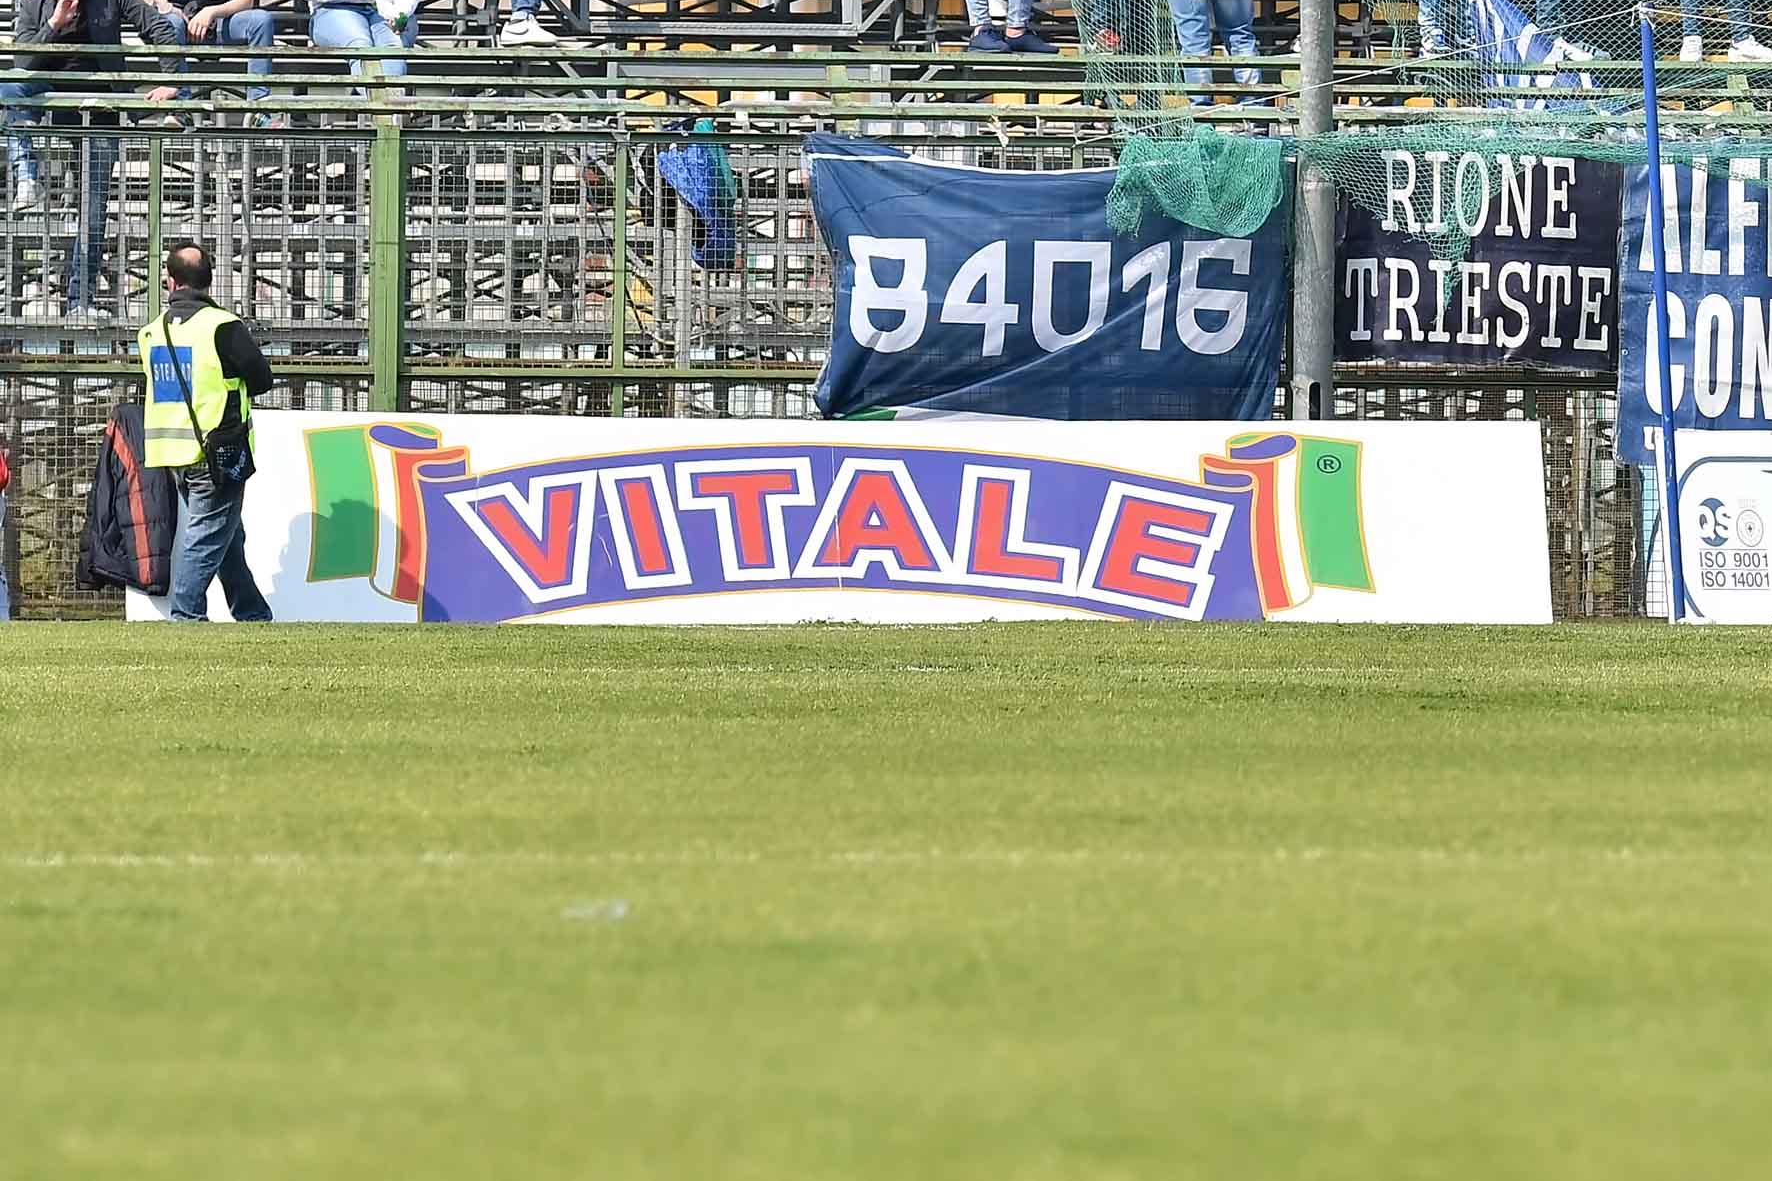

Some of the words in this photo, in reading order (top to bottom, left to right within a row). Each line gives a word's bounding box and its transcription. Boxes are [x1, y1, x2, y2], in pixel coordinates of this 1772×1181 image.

[1381, 149, 1578, 241] RIONE
[847, 237, 1252, 357] 84016
[1345, 256, 1612, 352] TRIESTE
[444, 455, 1234, 621] VITALE
[1699, 551, 1727, 568] ISO
[1733, 551, 1769, 568] 9001
[1701, 571, 1726, 588] ISO
[1731, 571, 1770, 588] 14001
